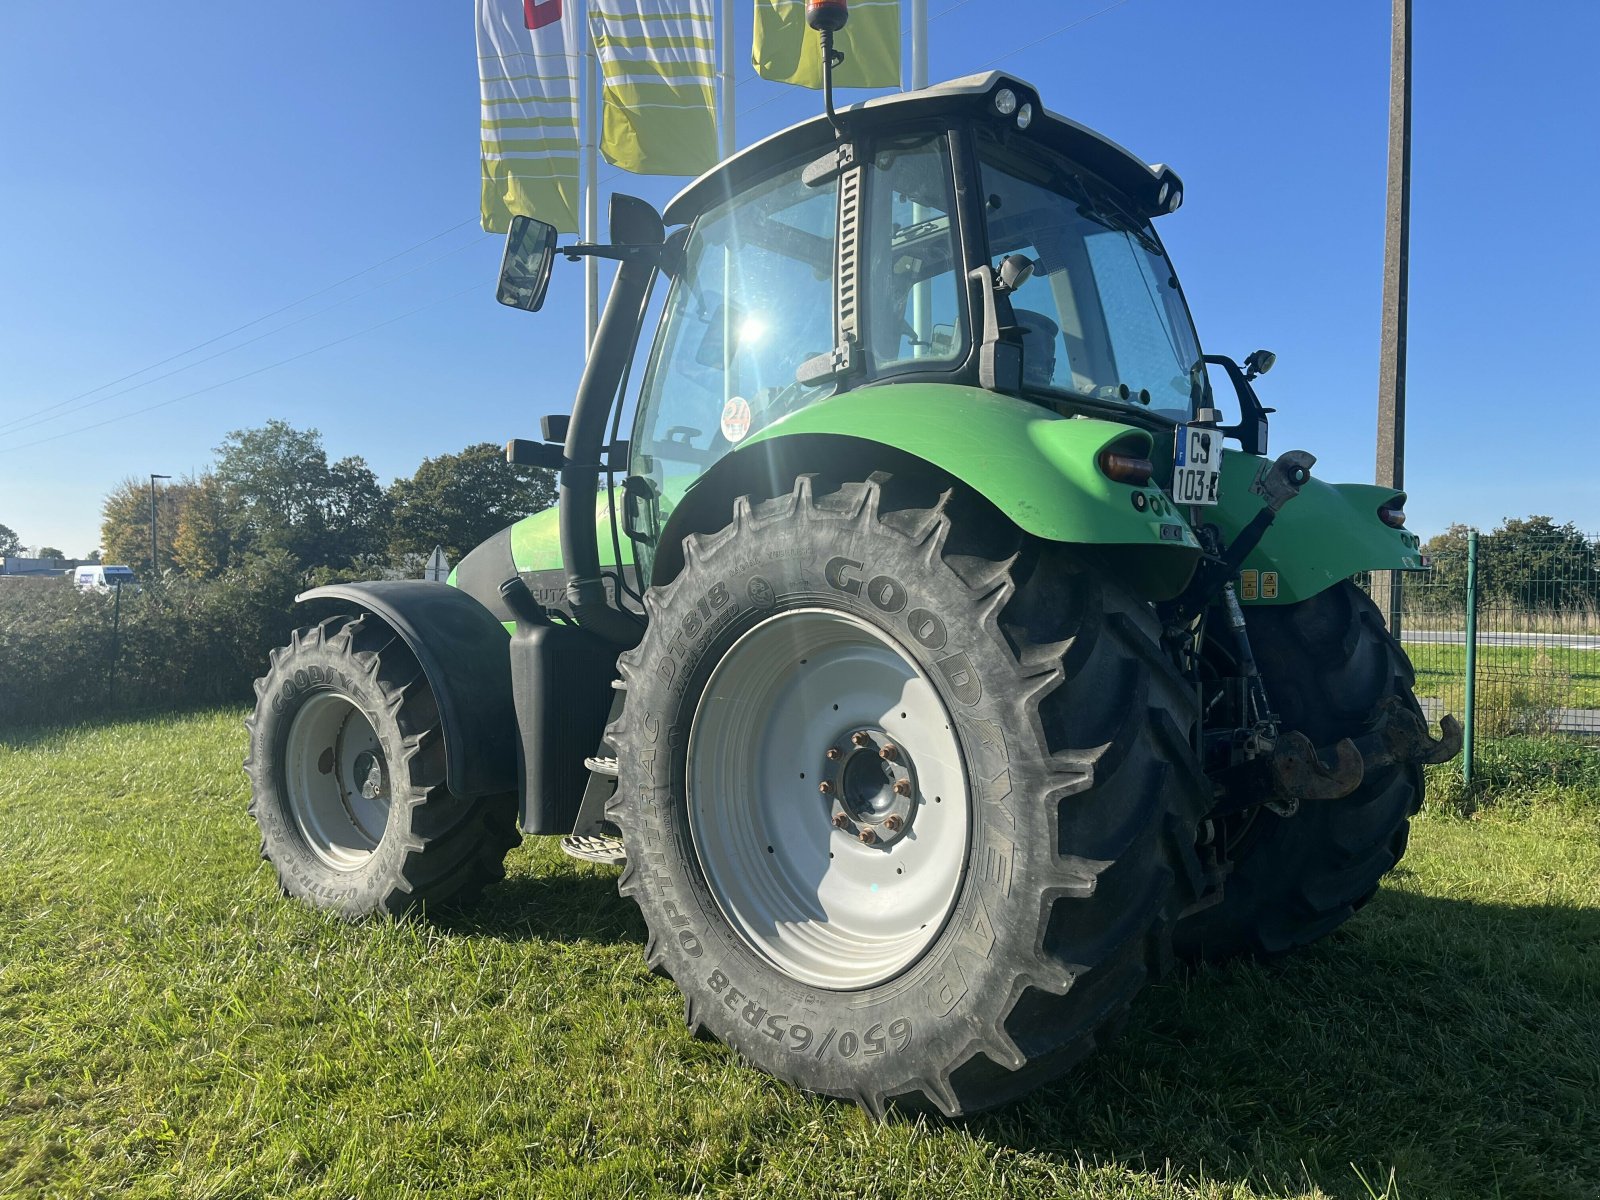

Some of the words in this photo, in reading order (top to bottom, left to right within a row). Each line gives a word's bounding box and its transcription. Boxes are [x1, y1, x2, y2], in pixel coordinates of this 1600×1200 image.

[656, 581, 729, 690] DT818
[696, 603, 740, 651] SPEED
[640, 711, 704, 959] OPTITRAC
[706, 968, 913, 1060] 650/65R38
